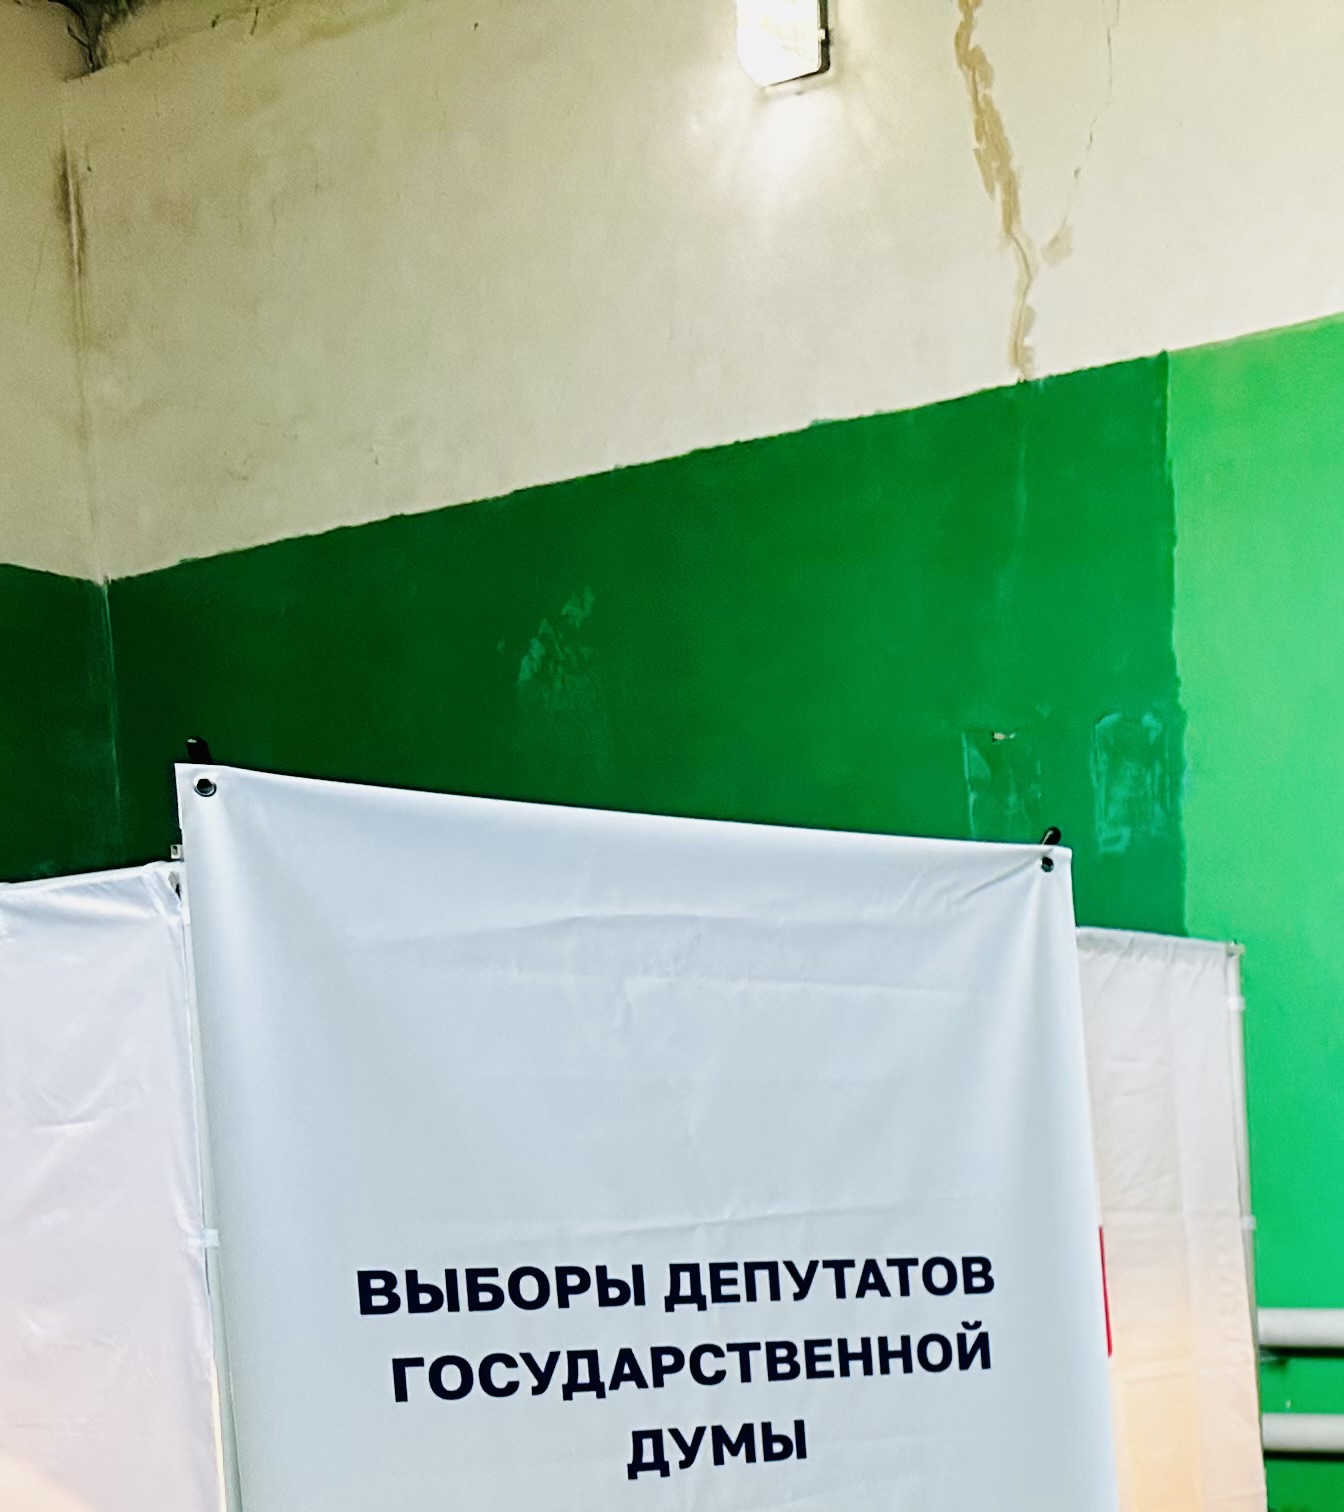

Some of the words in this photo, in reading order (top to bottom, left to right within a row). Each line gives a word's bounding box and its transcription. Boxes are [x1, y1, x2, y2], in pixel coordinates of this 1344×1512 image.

[356, 1263, 646, 1316] ВЫБОРЫ
[663, 1256, 995, 1313] ДЕПУТАТОВ
[391, 1320, 991, 1403] ГОСУДАРСТВЕННОЙ
[626, 1419, 807, 1481] ДУМЫ
